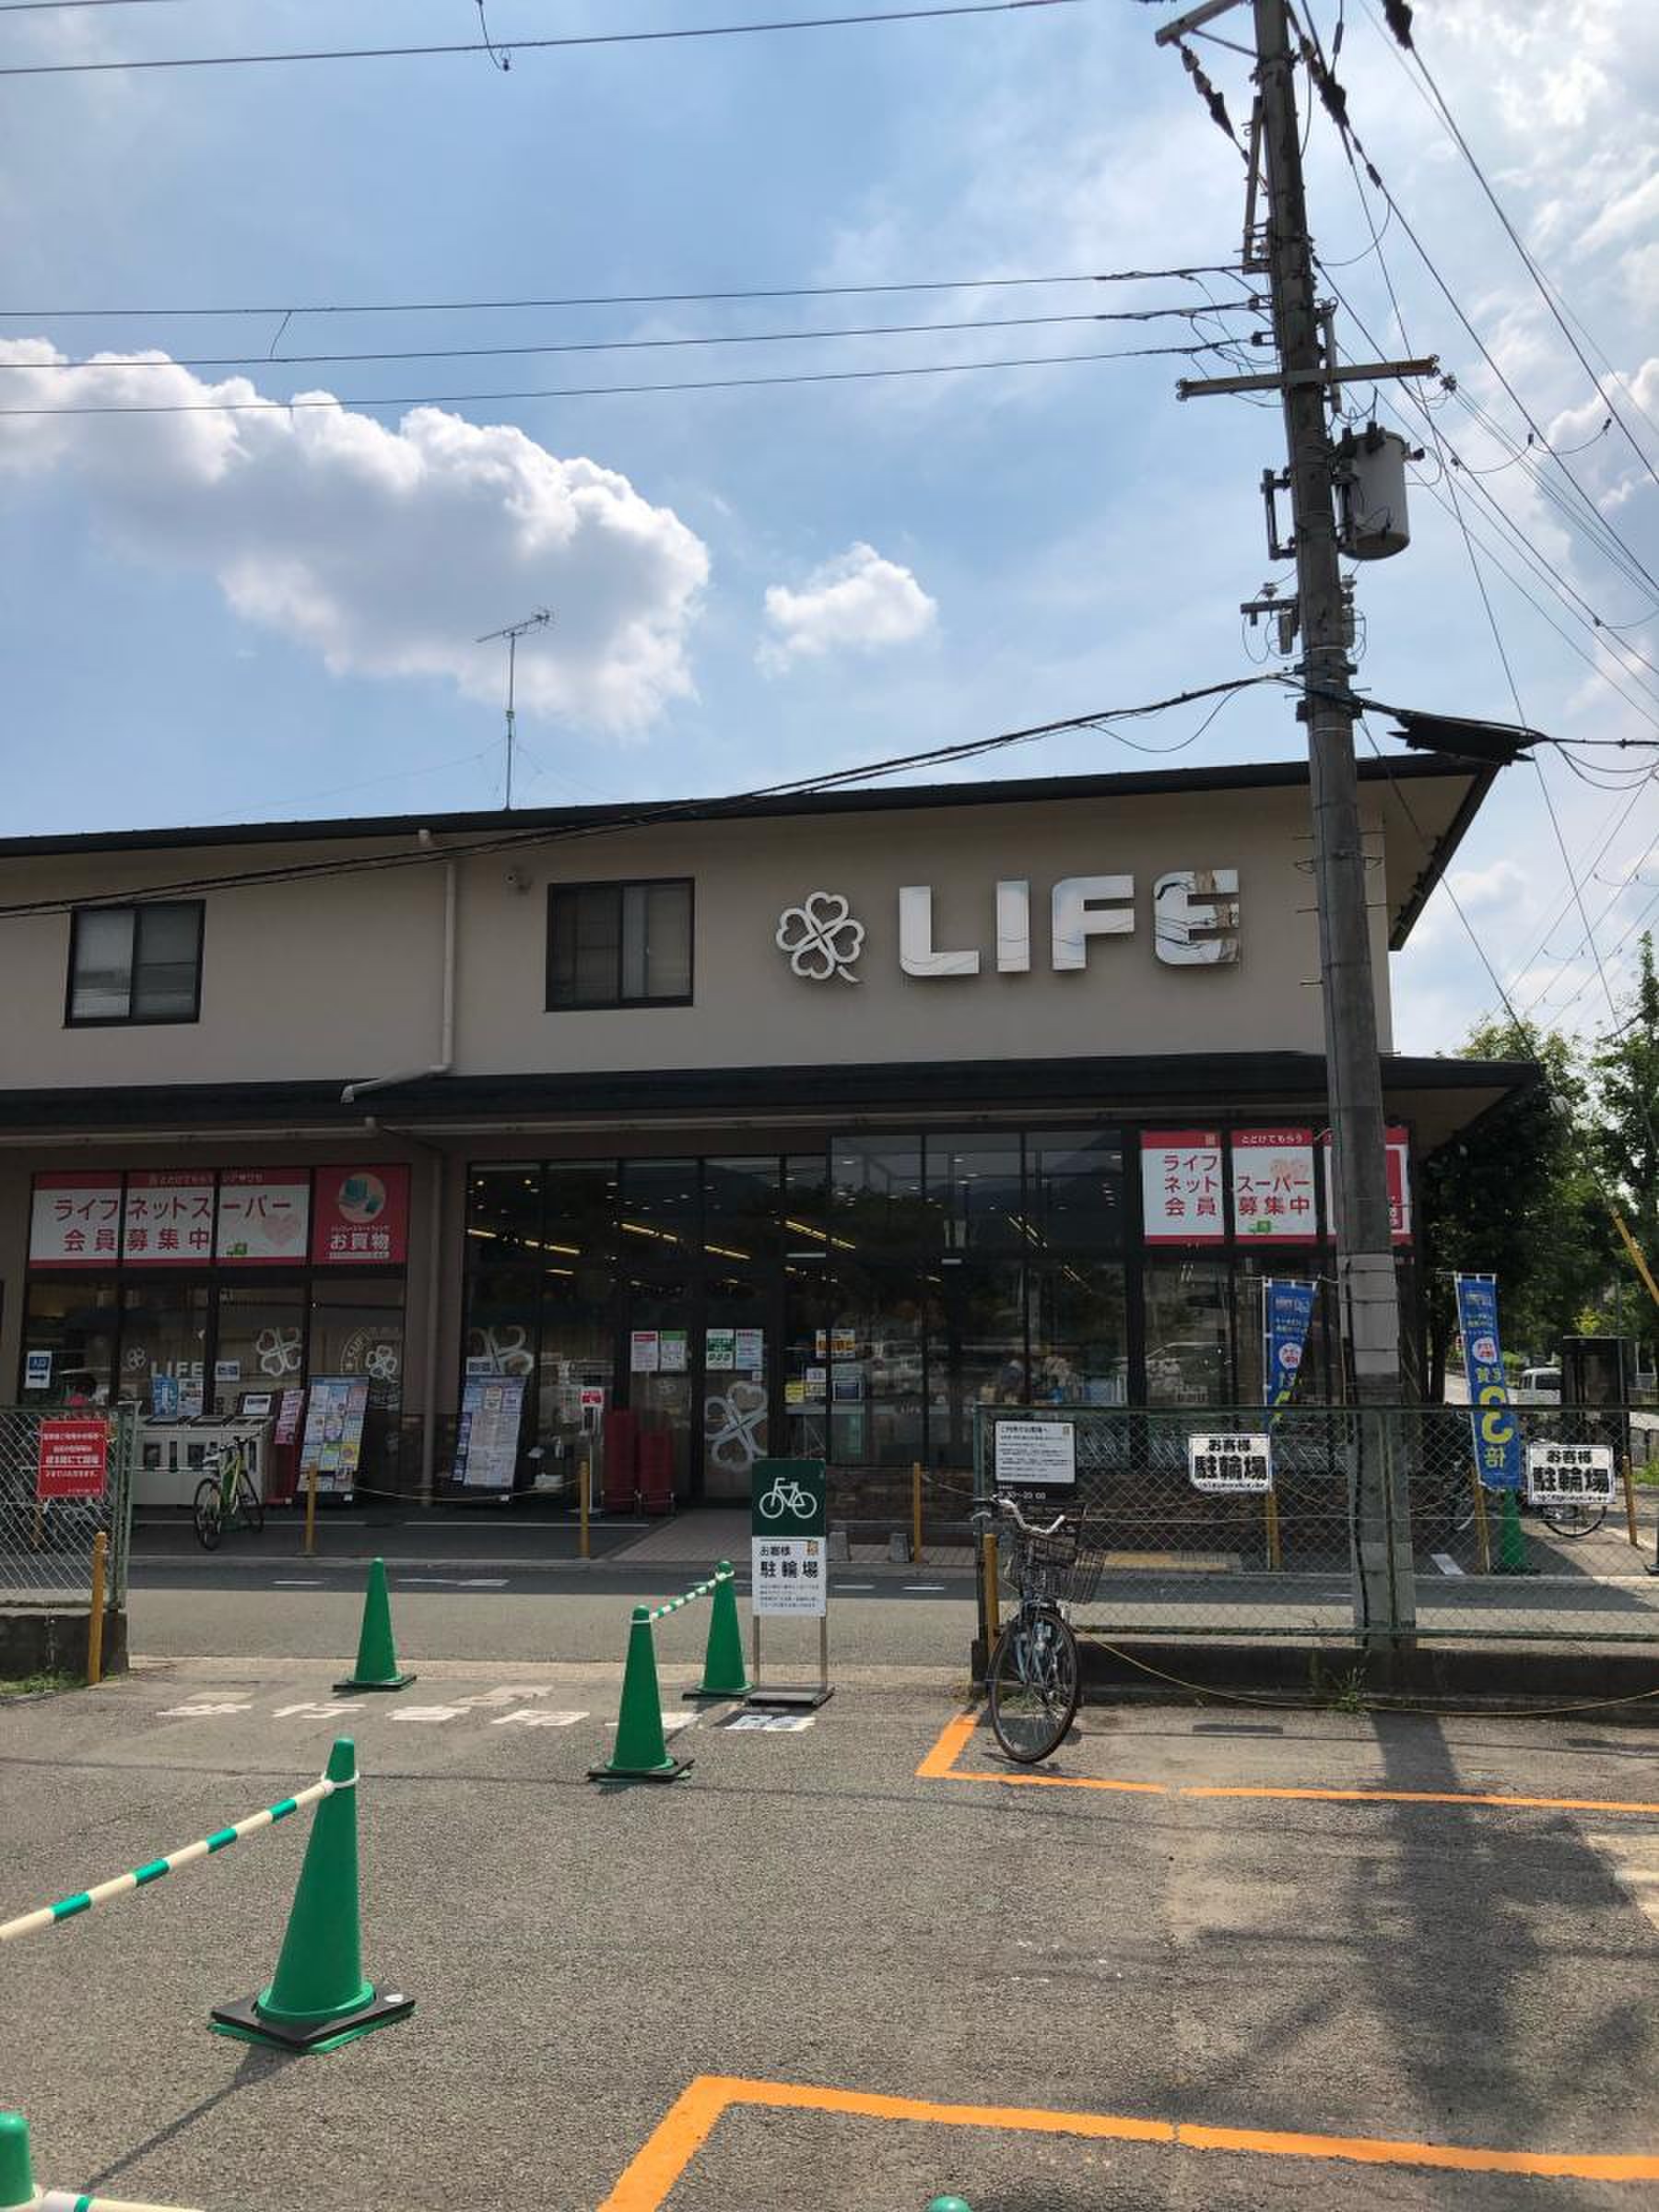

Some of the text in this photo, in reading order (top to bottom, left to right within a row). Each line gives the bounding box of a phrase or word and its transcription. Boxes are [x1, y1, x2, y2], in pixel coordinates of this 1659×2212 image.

[899, 869, 1240, 977] LIFE
[1164, 1155, 1218, 1171] ライフ
[1194, 1455, 1266, 1480] 駐輪場
[1533, 1467, 1609, 1492] 駐輪場
[759, 1546, 791, 1557] お客様
[759, 1561, 818, 1579] 駐輪場
